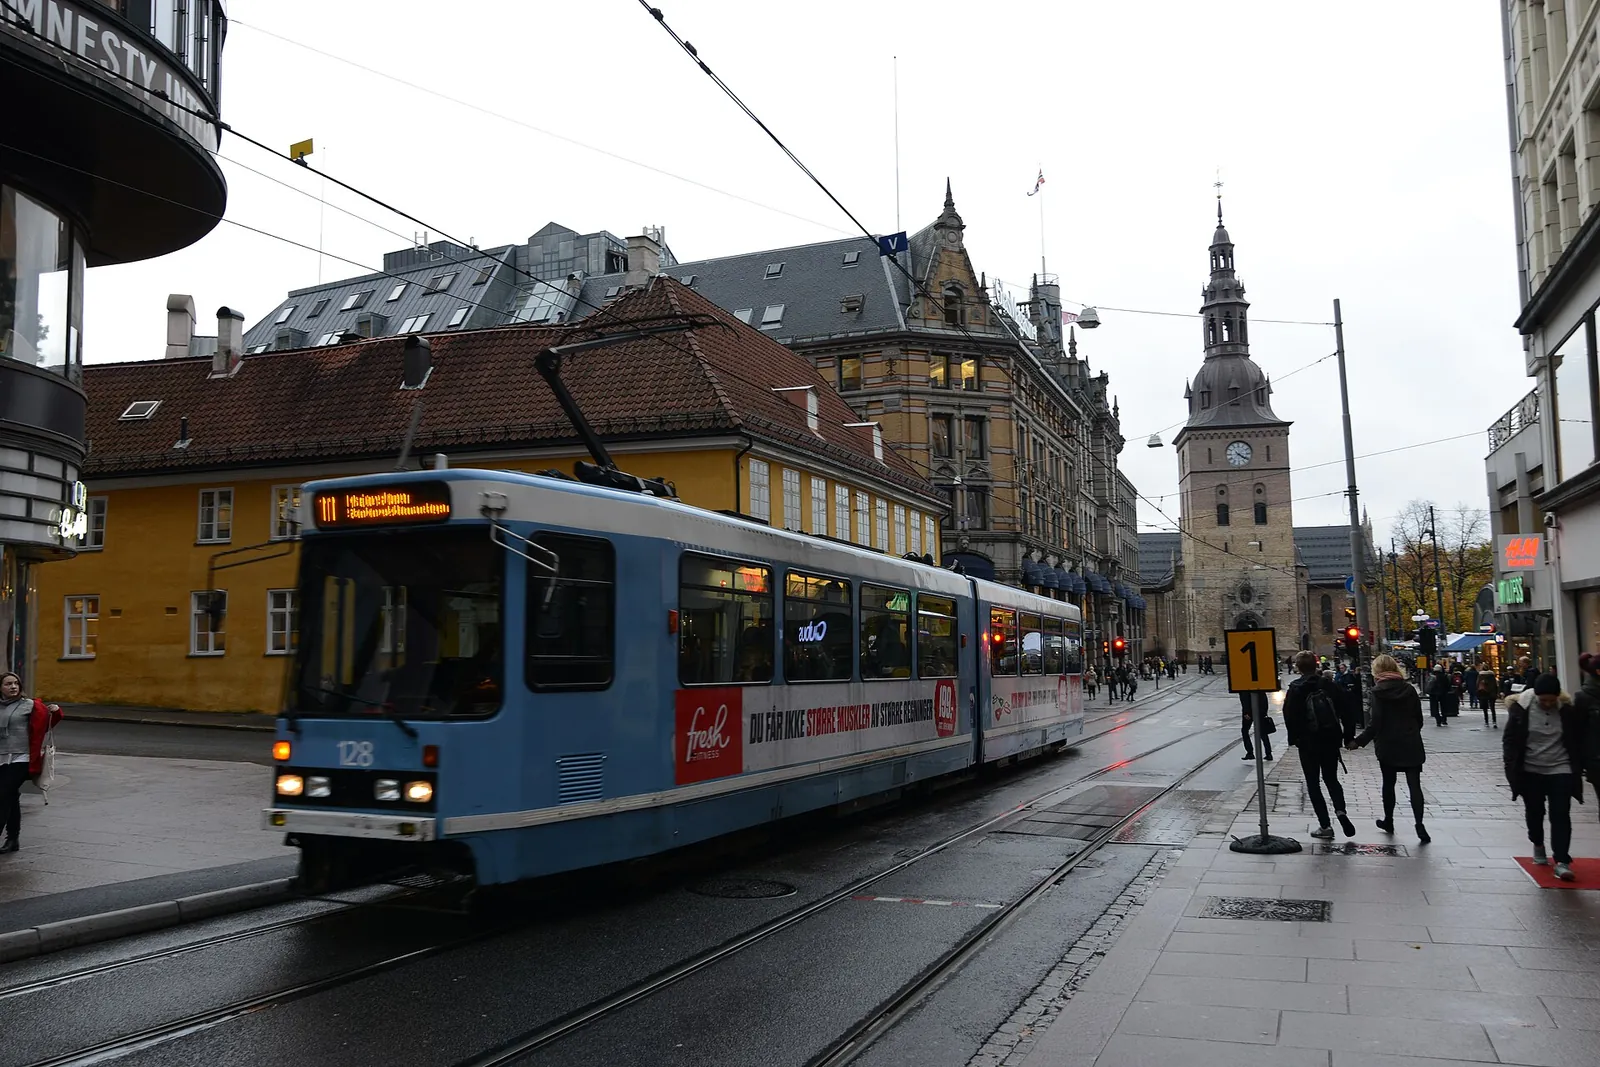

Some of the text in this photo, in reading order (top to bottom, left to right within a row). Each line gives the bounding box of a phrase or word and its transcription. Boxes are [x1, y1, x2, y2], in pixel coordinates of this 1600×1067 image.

[0, 0, 157, 101] MNESTY
[888, 236, 898, 250] V
[1239, 641, 1259, 682] 1
[685, 703, 731, 763] fresh
[749, 712, 764, 745] DU
[765, 704, 784, 743] FÅR
[784, 709, 806, 740] IKKE
[806, 705, 836, 738] STØRRE
[837, 703, 871, 733] MUSKLER
[871, 703, 880, 729] AV
[880, 700, 903, 727] STØRRE
[336, 740, 374, 767] 128
